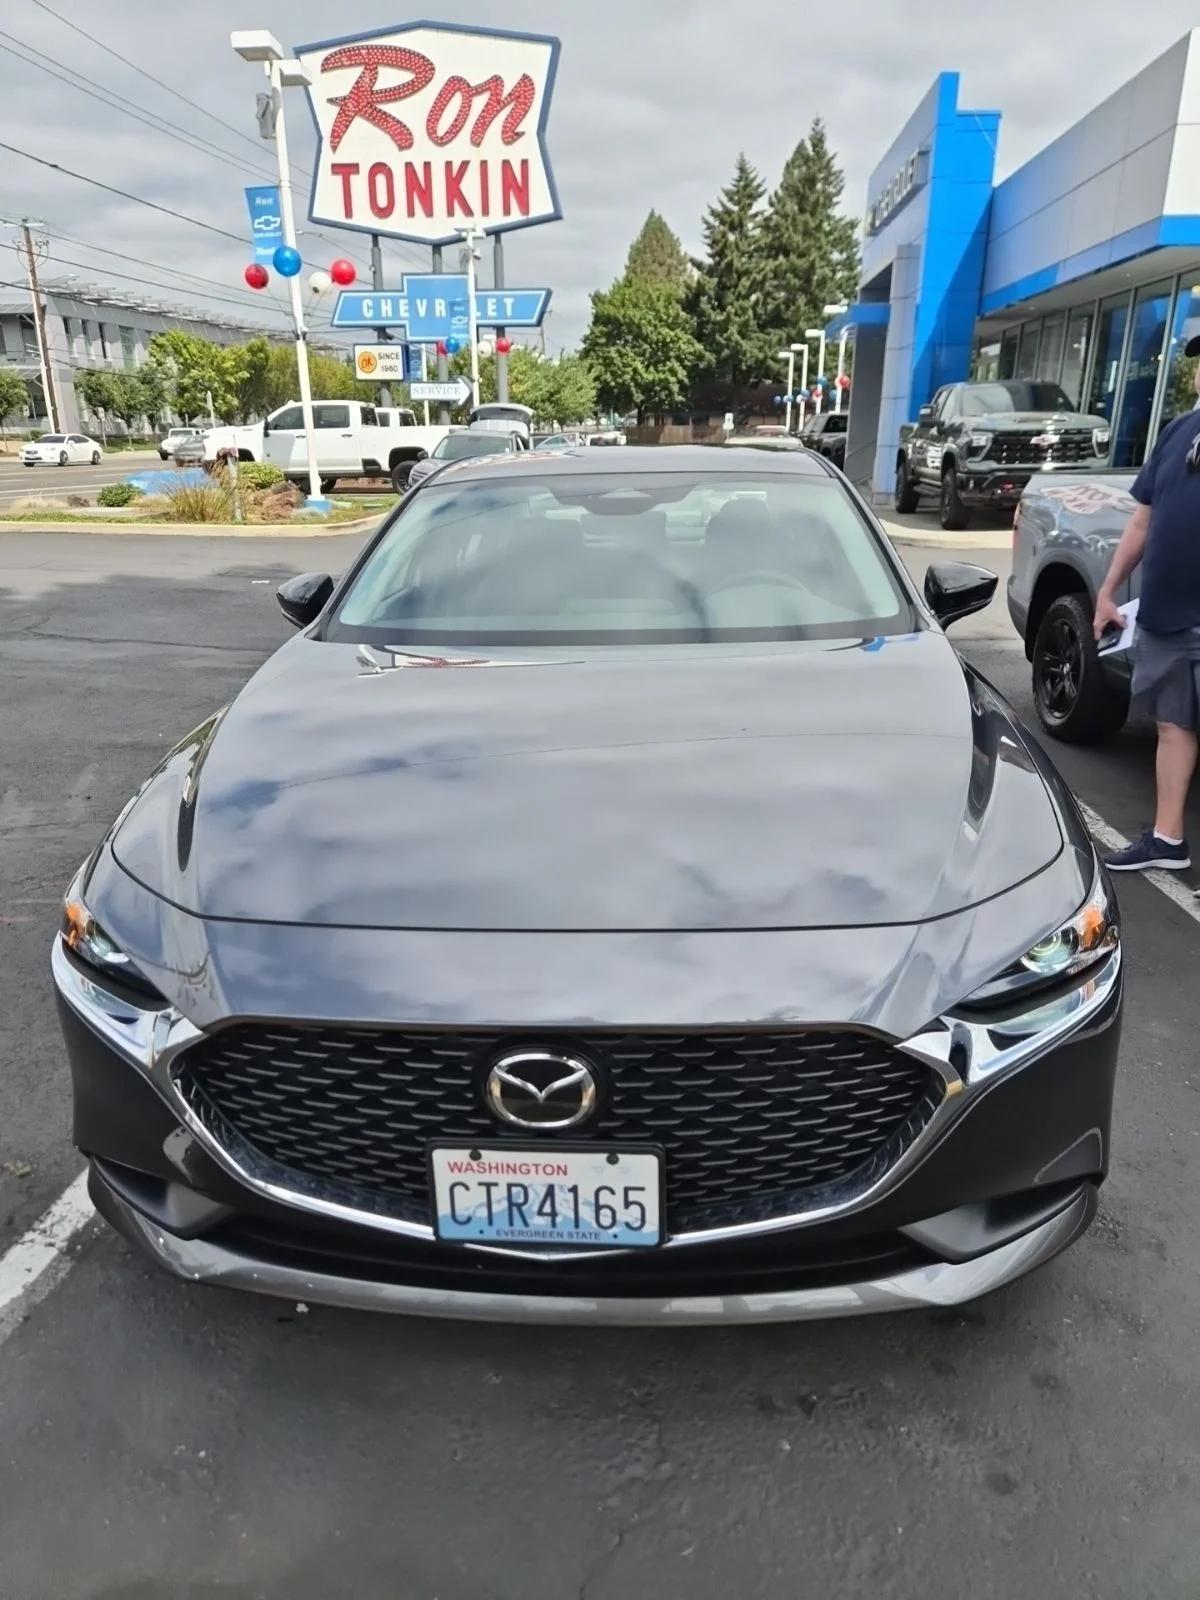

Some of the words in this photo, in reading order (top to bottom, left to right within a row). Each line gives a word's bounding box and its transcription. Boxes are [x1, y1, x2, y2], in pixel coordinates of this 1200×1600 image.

[320, 44, 536, 154] Ron
[330, 158, 530, 219] TONKIN
[362, 297, 515, 318] CHEVRET
[377, 352, 400, 360] SINCE
[381, 364, 399, 372] 1960
[412, 386, 462, 395] SERVICE
[447, 1161, 568, 1176] WASHINGTON
[448, 1181, 647, 1232] CTR4165
[495, 1229, 564, 1239] EVERGREEN
[567, 1231, 601, 1240] STATE
